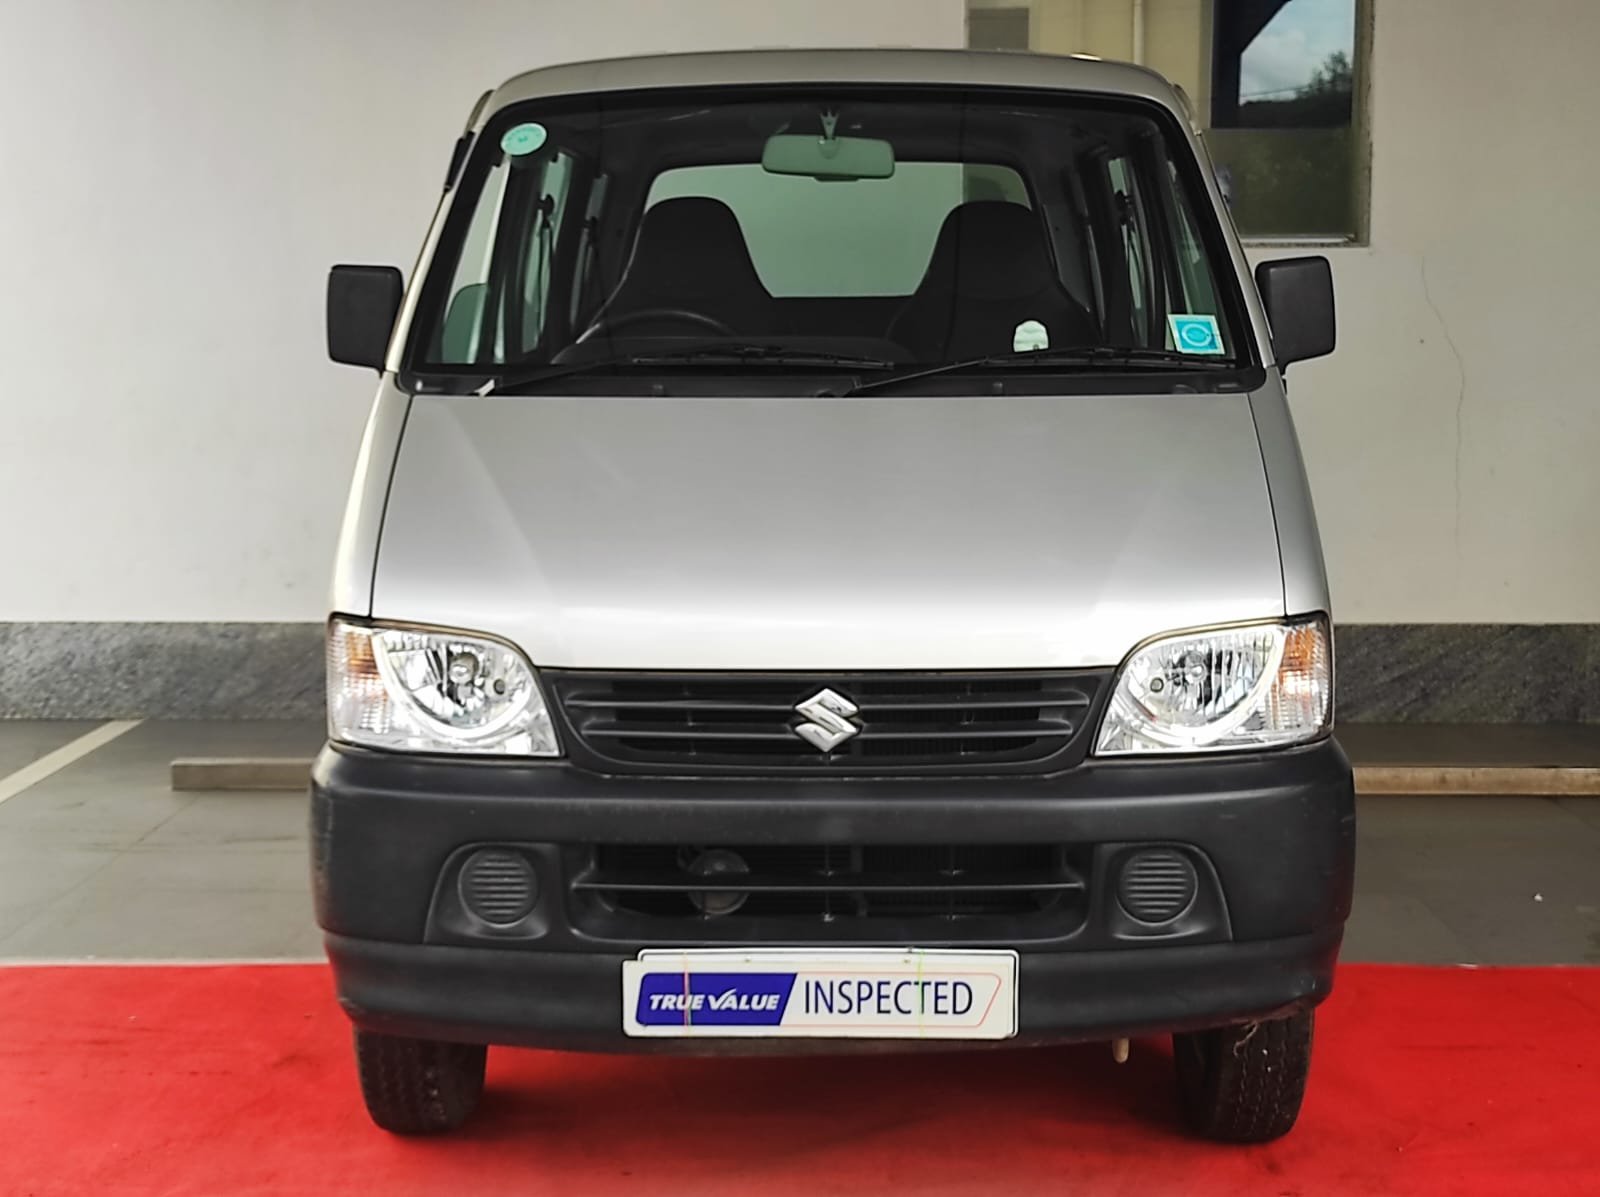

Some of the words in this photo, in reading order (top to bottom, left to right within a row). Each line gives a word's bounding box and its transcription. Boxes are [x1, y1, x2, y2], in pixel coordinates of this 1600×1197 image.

[649, 993, 706, 1011] TRUE
[707, 988, 781, 1011] VALUE
[804, 979, 974, 1016] INSPECTED
